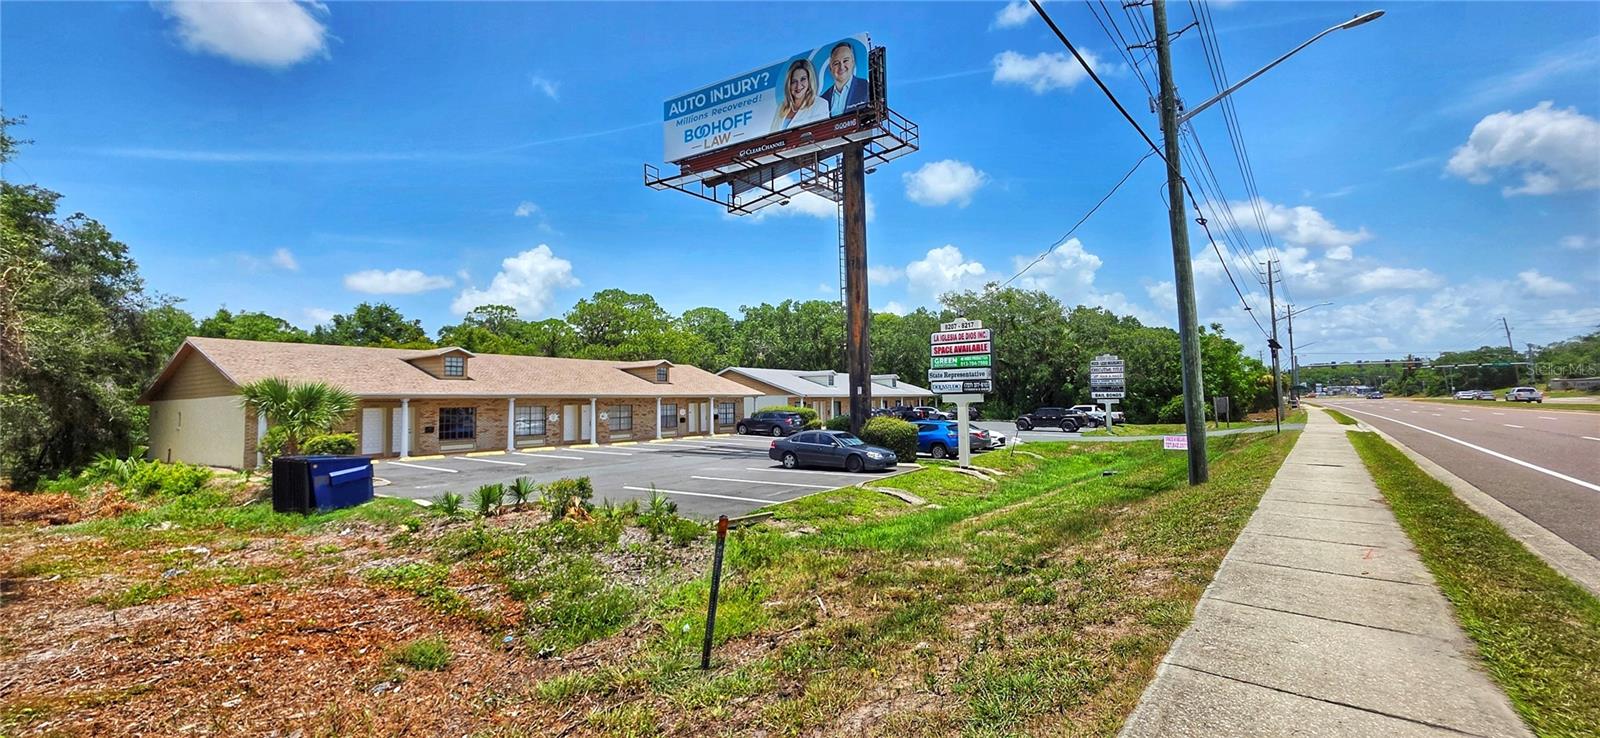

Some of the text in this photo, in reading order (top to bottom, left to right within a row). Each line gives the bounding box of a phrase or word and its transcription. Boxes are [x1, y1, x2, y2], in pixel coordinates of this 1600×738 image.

[669, 72, 770, 117] AUTO INJURY?
[675, 94, 763, 127] Millions Recovered!
[684, 110, 753, 143] BOOHOFF
[703, 132, 731, 149] LAW
[958, 332, 964, 340] DE
[965, 331, 977, 340] DIOS
[933, 343, 988, 354] SPACE AVAILABLE
[944, 371, 986, 380] Representative
